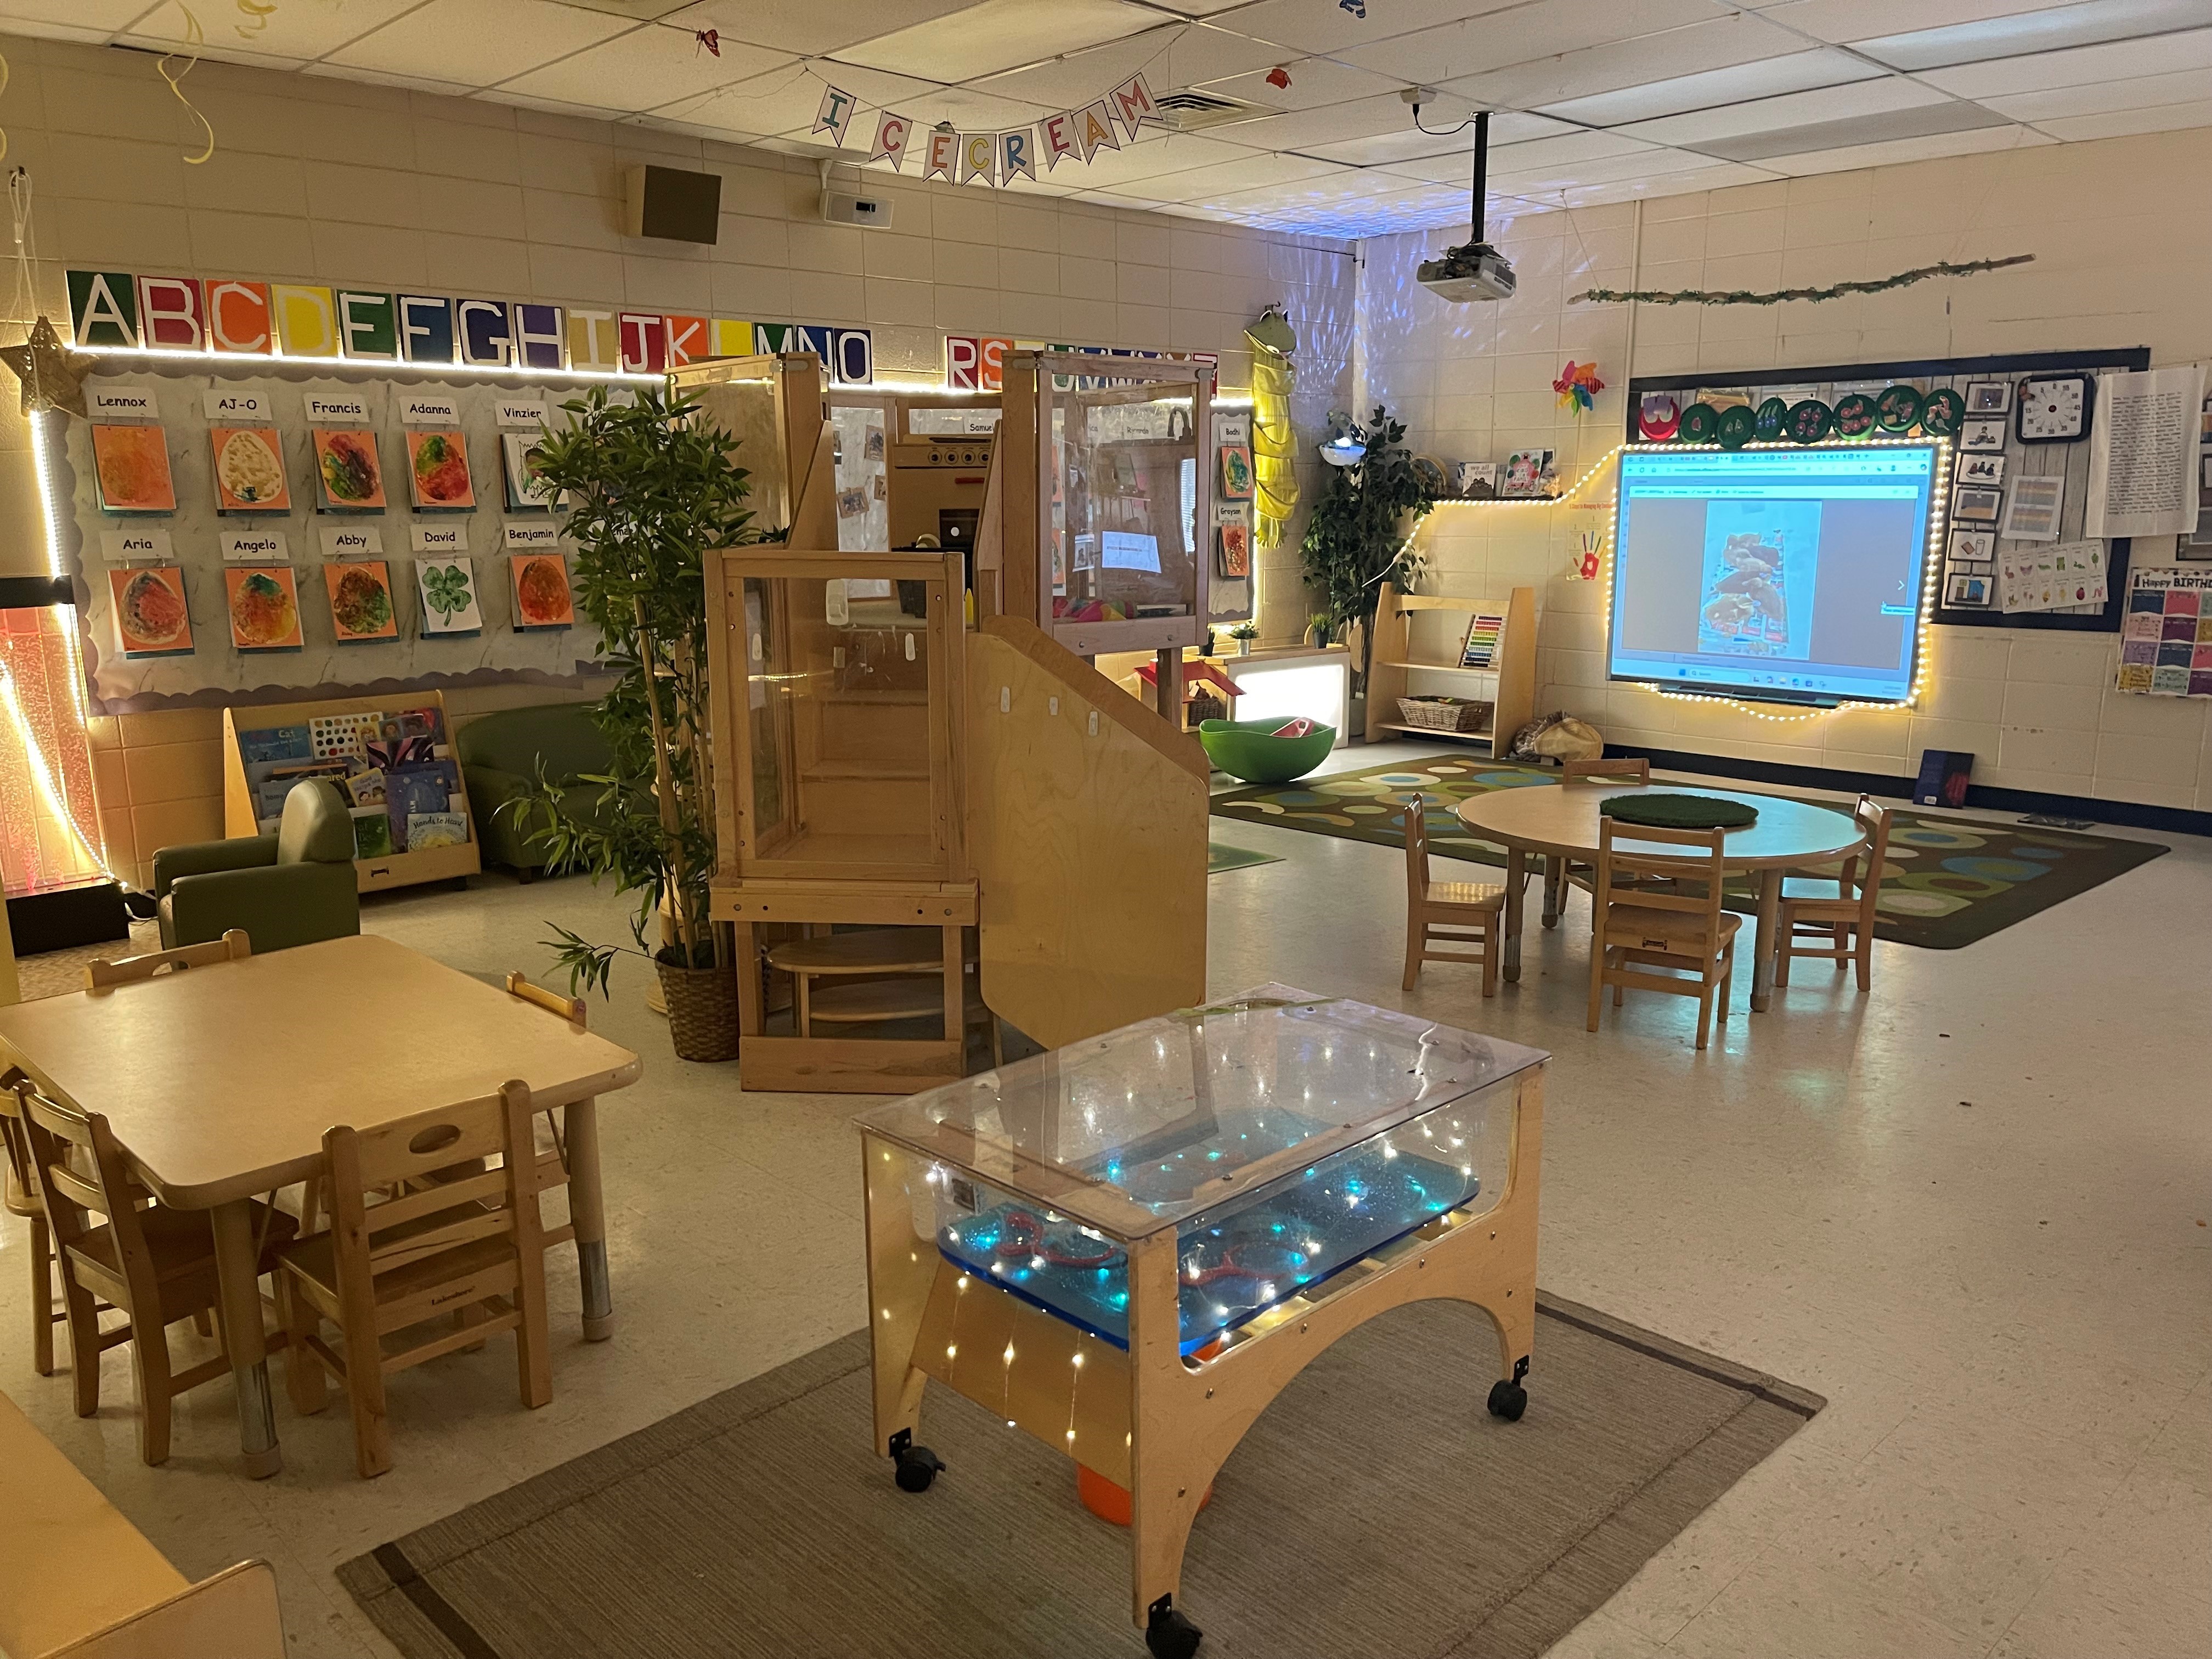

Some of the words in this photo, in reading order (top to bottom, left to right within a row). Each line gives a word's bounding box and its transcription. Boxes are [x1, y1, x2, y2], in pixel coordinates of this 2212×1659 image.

[97, 396, 147, 408] Lennox
[218, 398, 257, 411] AJ-O
[312, 401, 362, 414] Francis
[410, 403, 452, 416] Adanna
[503, 408, 541, 417] Vinzier
[1221, 507, 1241, 516] Grayson
[424, 531, 456, 543] David
[509, 528, 554, 540] Benjamin
[123, 539, 153, 550] Aria
[234, 539, 276, 553] Angelo
[336, 534, 366, 548] Abby
[2142, 578, 2171, 588] Happy
[413, 816, 436, 829] Hands
